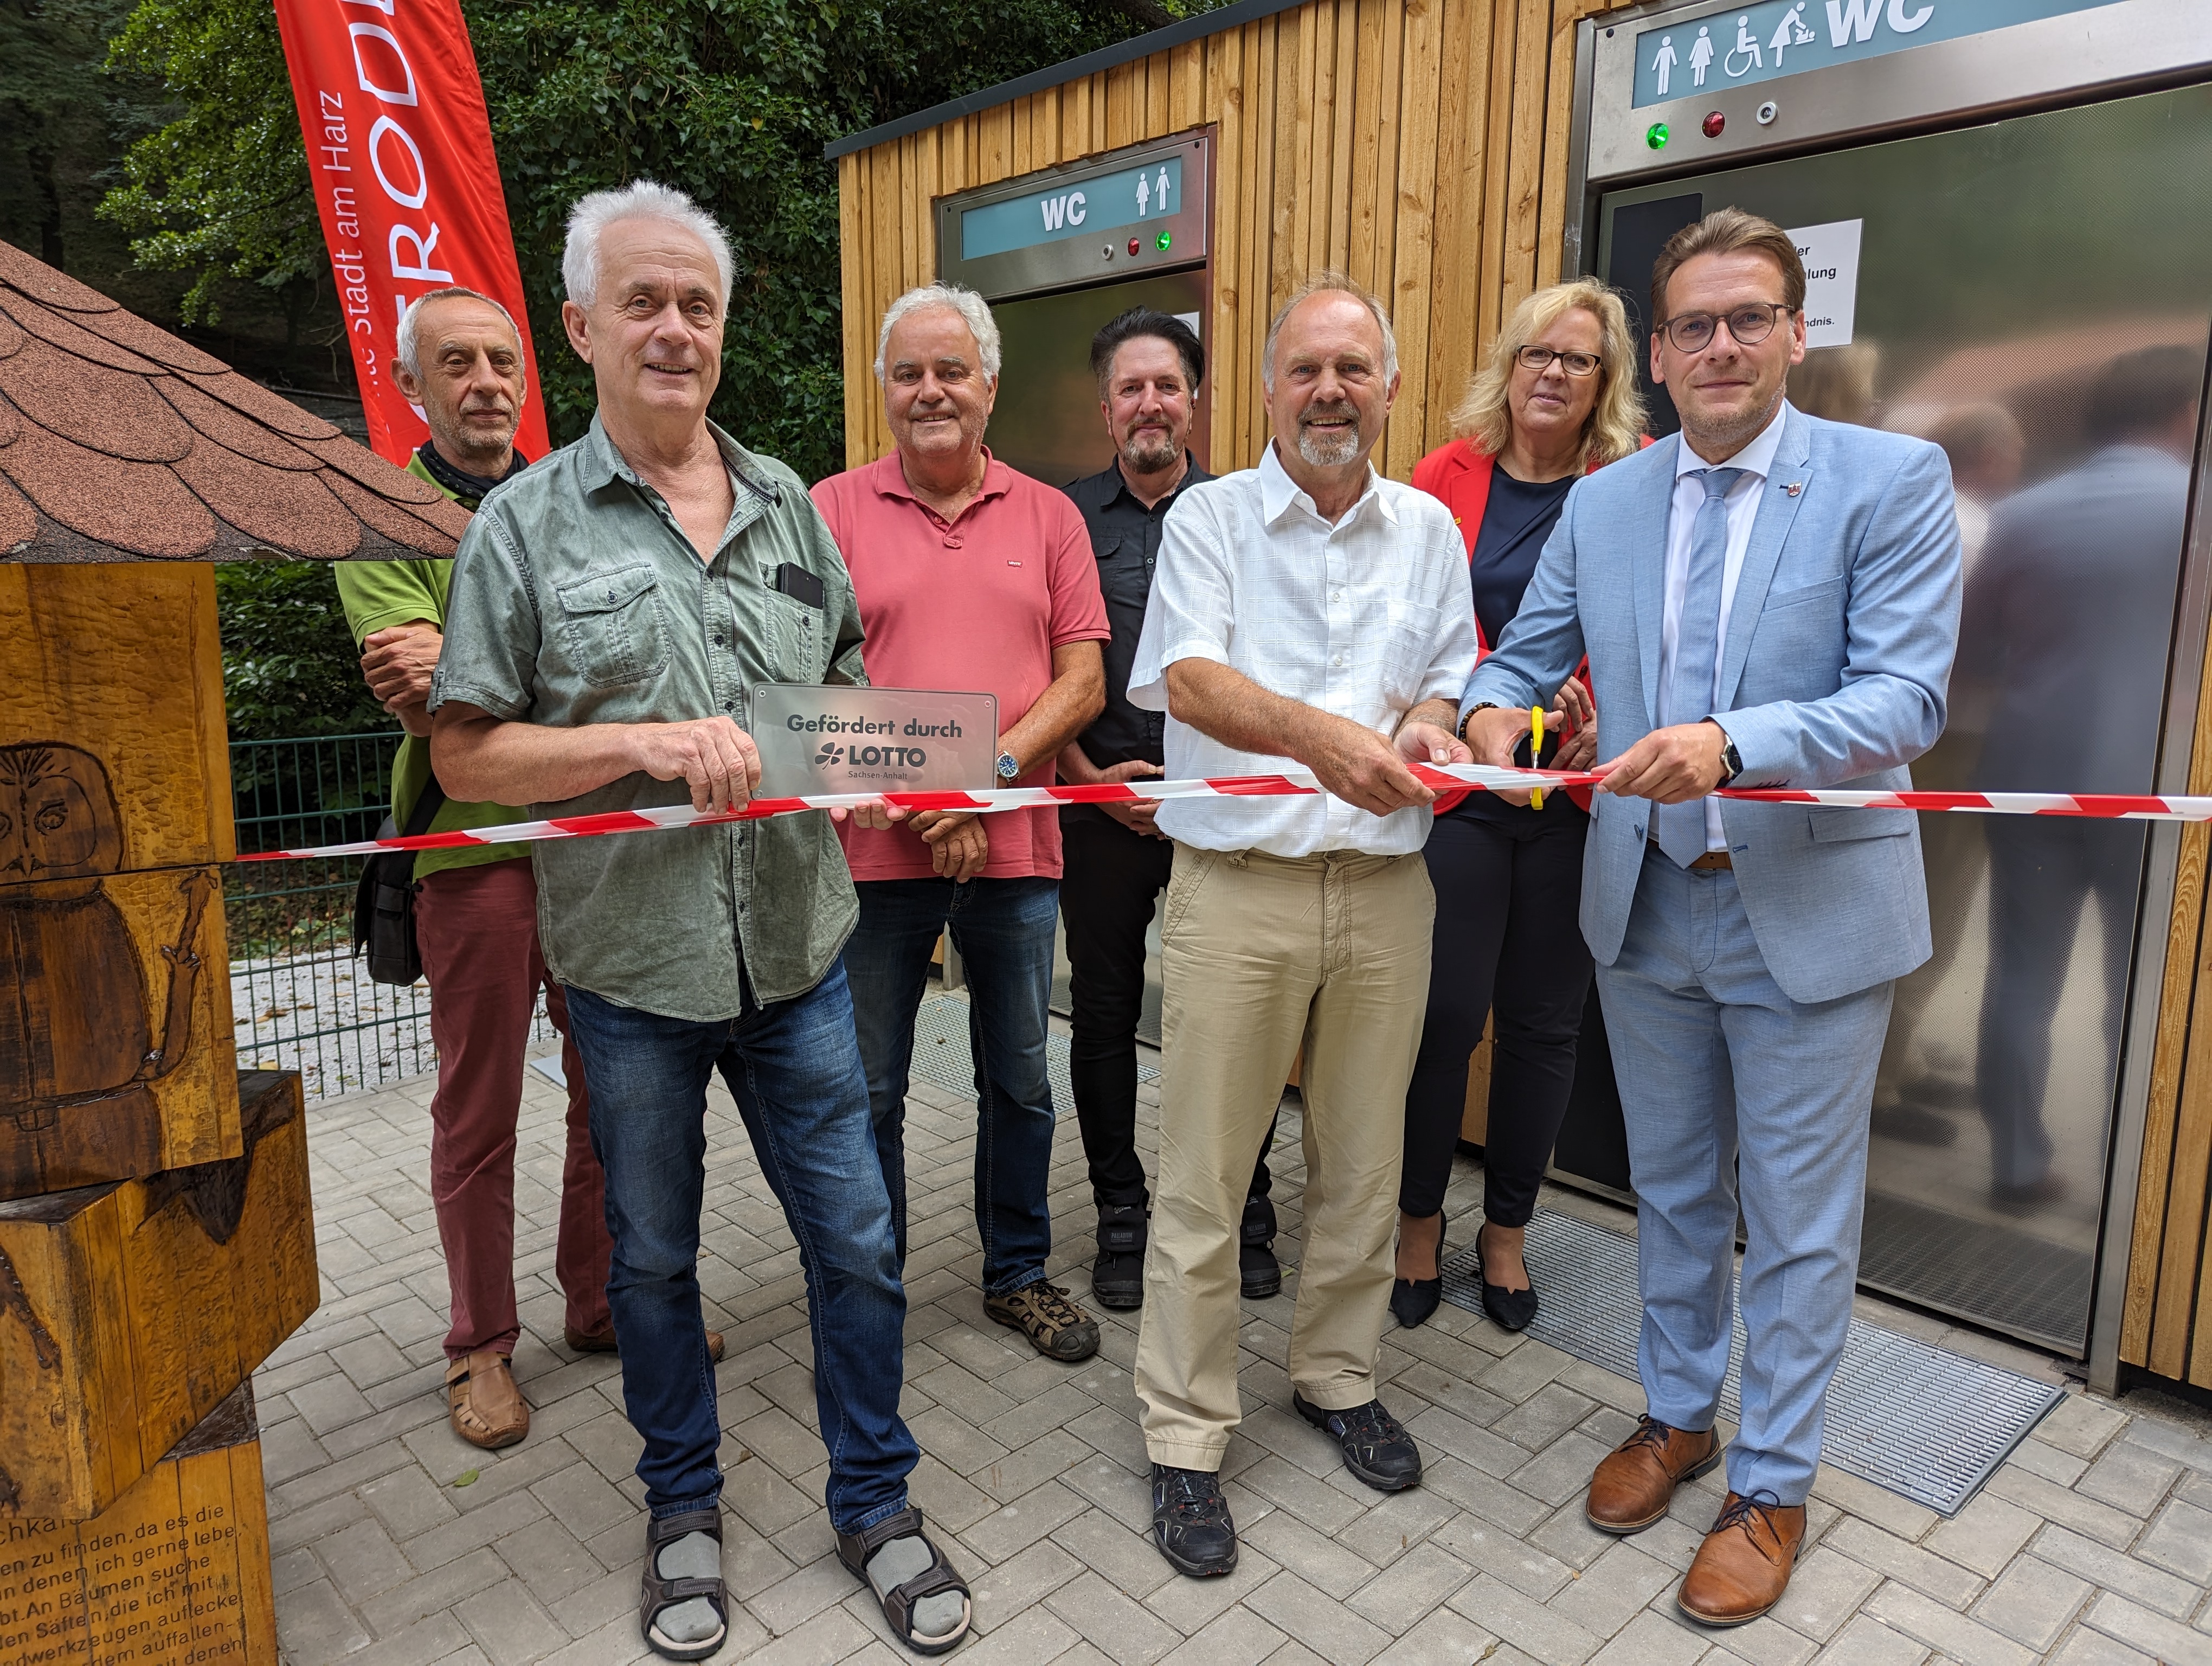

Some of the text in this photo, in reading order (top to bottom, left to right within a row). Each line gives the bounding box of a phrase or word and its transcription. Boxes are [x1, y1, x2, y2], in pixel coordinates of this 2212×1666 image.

[1825, 0, 1934, 48] WC
[319, 90, 352, 172] Harz
[333, 187, 360, 238] am
[1040, 191, 1086, 232] WC
[1805, 267, 1836, 280] lung
[787, 714, 962, 738] Gefördert durch
[848, 745, 927, 767] LOTTO
[848, 771, 908, 780] Sachsen-Anhalt
[31, 1552, 54, 1568] zu
[165, 1516, 189, 1530] es
[196, 1505, 223, 1522] die
[23, 1567, 88, 1594] denen
[95, 1554, 125, 1574] ich
[133, 1539, 189, 1567] gerne
[59, 1575, 144, 1610] Bäumen
[151, 1556, 210, 1582] suche
[146, 1586, 175, 1607] ich
[182, 1575, 214, 1597] mit
